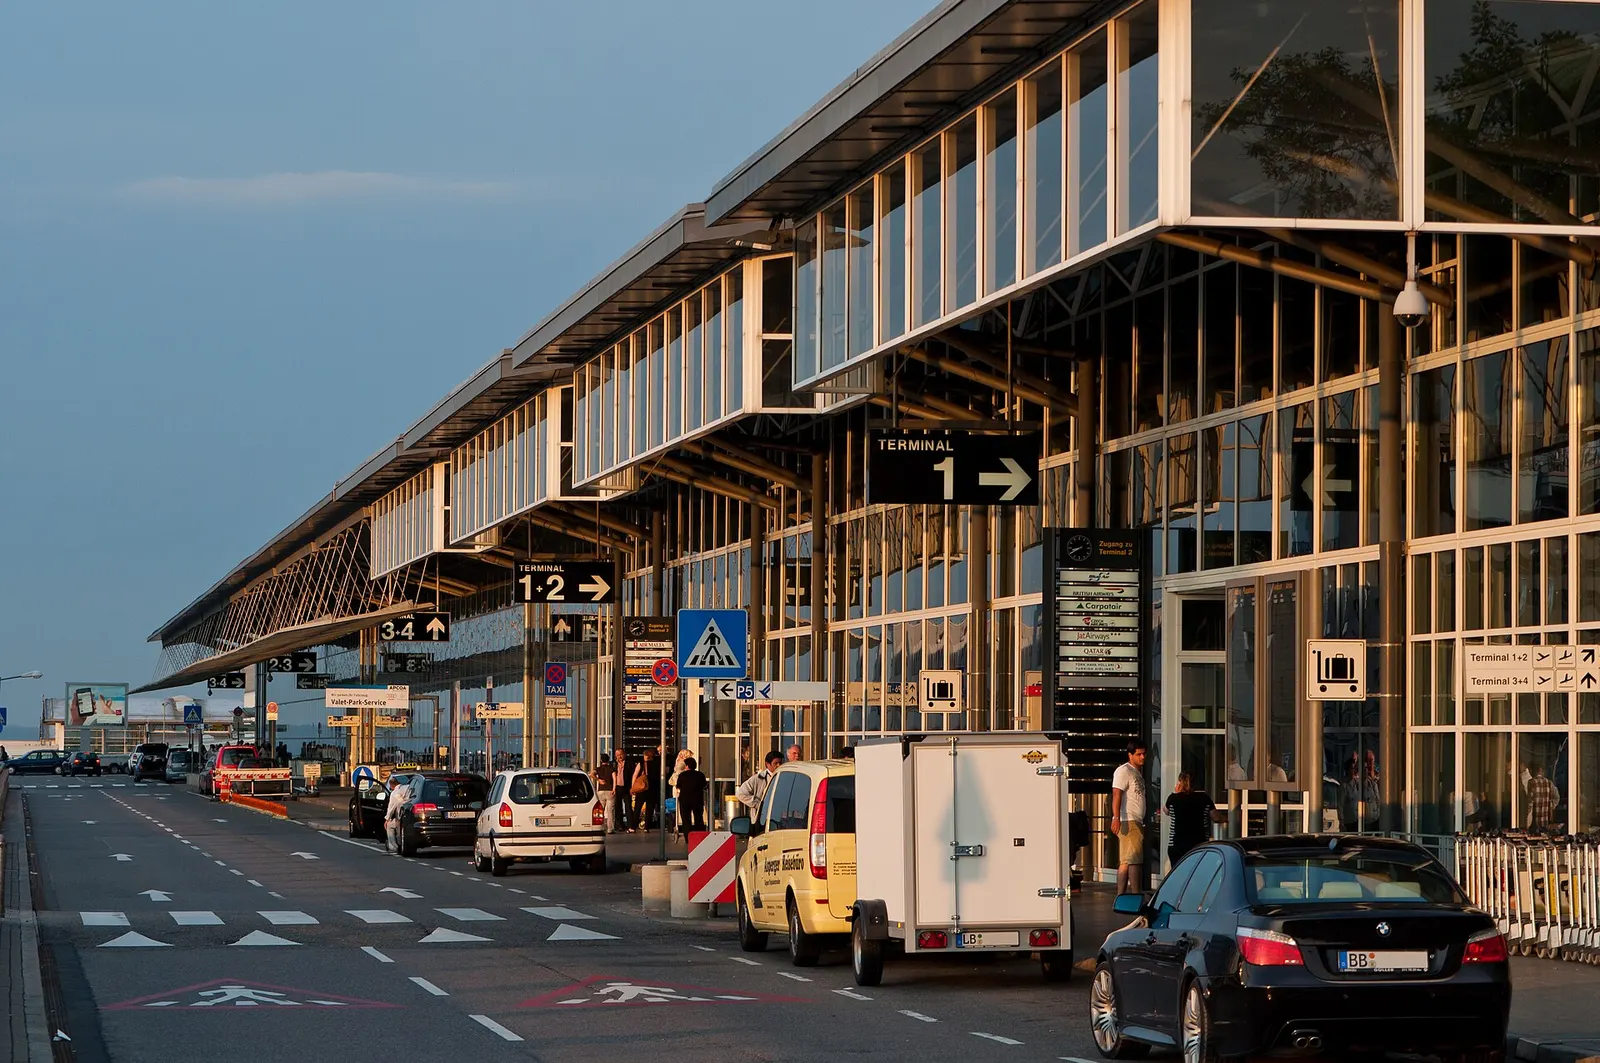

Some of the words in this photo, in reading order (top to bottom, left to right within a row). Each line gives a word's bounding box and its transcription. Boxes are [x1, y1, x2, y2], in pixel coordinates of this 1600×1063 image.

[878, 439, 954, 451] TERMINAL
[934, 456, 954, 500] 1
[1086, 602, 1122, 610] Carpatair
[1470, 653, 1509, 662] Terminal
[1512, 653, 1528, 662] 1+2
[1471, 677, 1510, 686] Terminal
[1512, 677, 1528, 685] 3+4
[737, 685, 753, 698] P5
[962, 934, 977, 945] LB
[1348, 953, 1368, 967] BB
